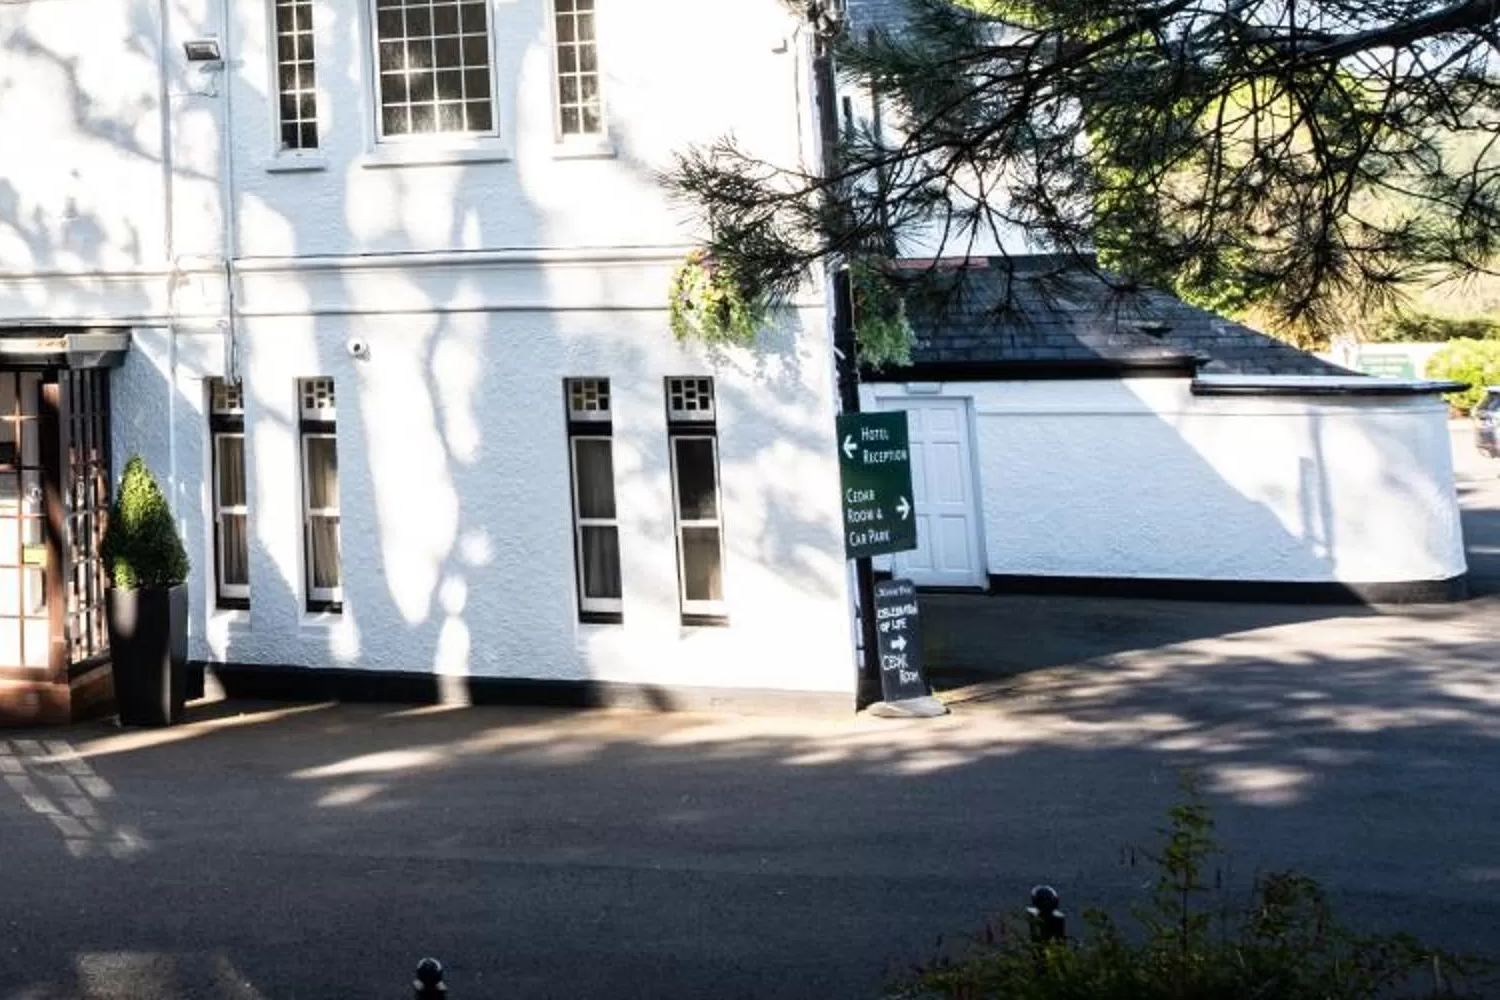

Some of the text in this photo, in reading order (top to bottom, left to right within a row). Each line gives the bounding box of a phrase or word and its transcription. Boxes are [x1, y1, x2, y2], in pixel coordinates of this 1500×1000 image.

[861, 427, 890, 441] HOTEL
[863, 450, 908, 464] RECEPTION
[846, 488, 875, 503] CEDAR
[847, 508, 883, 523] ROOM &
[850, 529, 891, 546] CAR PARK
